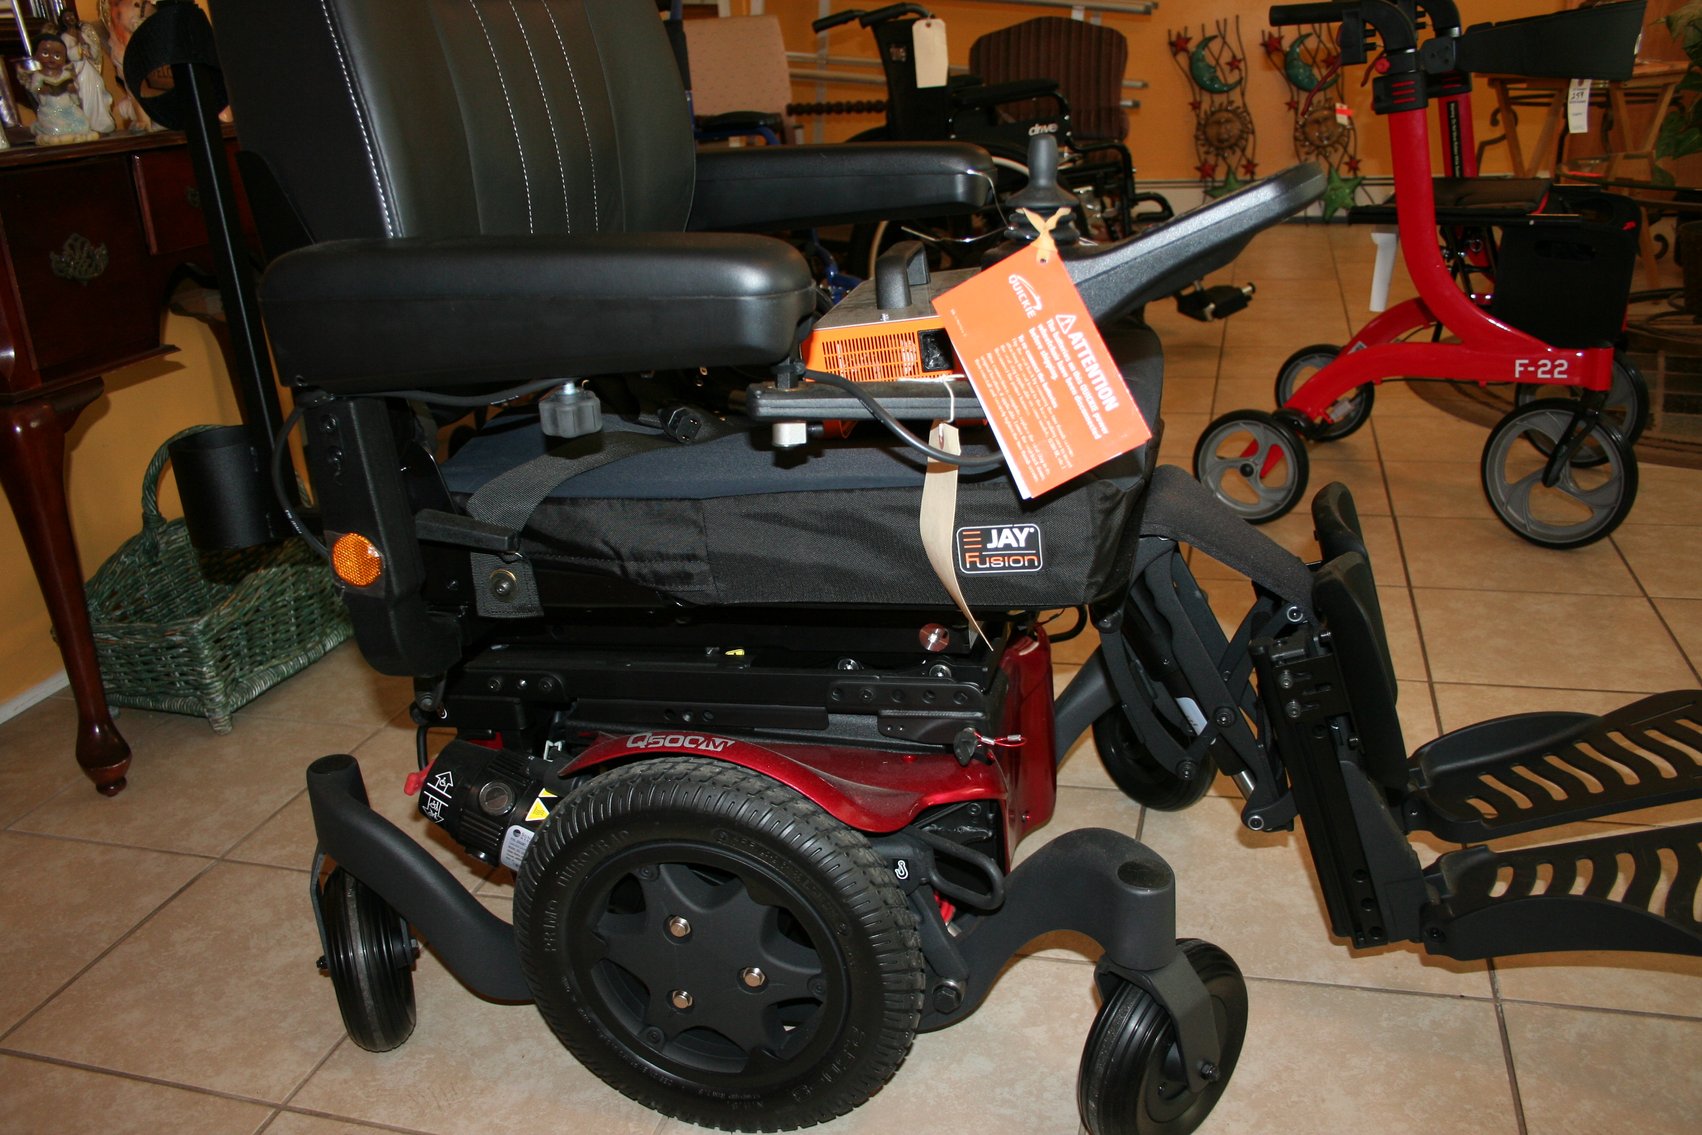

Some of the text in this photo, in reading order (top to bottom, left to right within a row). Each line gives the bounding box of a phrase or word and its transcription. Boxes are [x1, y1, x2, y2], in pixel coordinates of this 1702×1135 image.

[1008, 275, 1036, 319] QUICKIE
[1028, 327, 1044, 350] before
[1036, 323, 1060, 361] wheelchair
[1056, 360, 1069, 378] have
[1073, 393, 1102, 440] disconnected
[1045, 318, 1057, 332] The
[1051, 330, 1072, 362] batteries
[1079, 383, 1098, 412] QUICKIE
[1093, 412, 1108, 435] power
[1066, 328, 1120, 412] ATTENTION
[1514, 359, 1568, 378] F-22
[965, 552, 1038, 568] Fusion
[986, 527, 1029, 549] JAY
[543, 899, 558, 953] PRIMO
